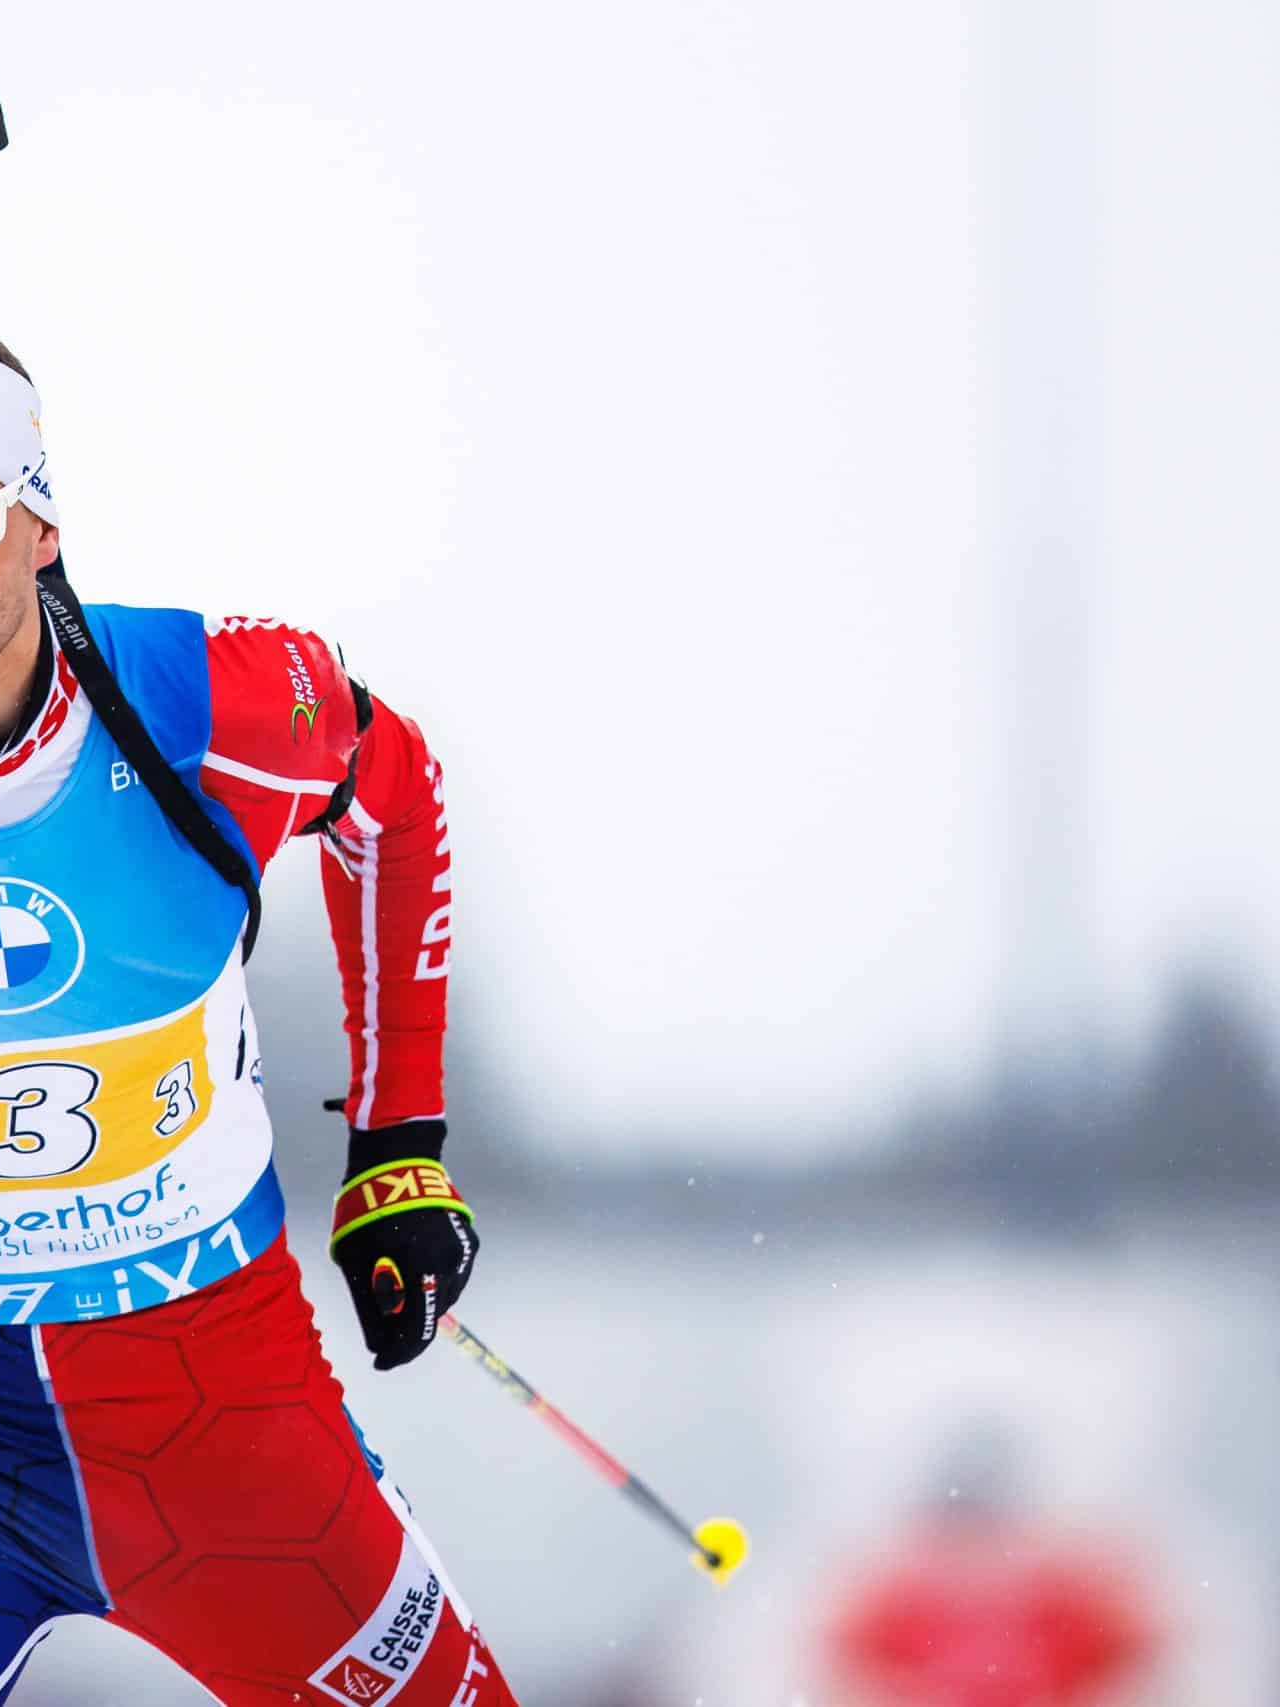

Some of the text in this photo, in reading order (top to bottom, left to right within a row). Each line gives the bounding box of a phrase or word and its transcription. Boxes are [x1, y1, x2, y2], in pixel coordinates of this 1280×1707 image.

[60, 615, 88, 650] Lain
[283, 640, 317, 705] ENERGIE
[287, 666, 306, 703] ROY
[154, 1061, 198, 1137] 3
[370, 1587, 423, 1662] CAISSE
